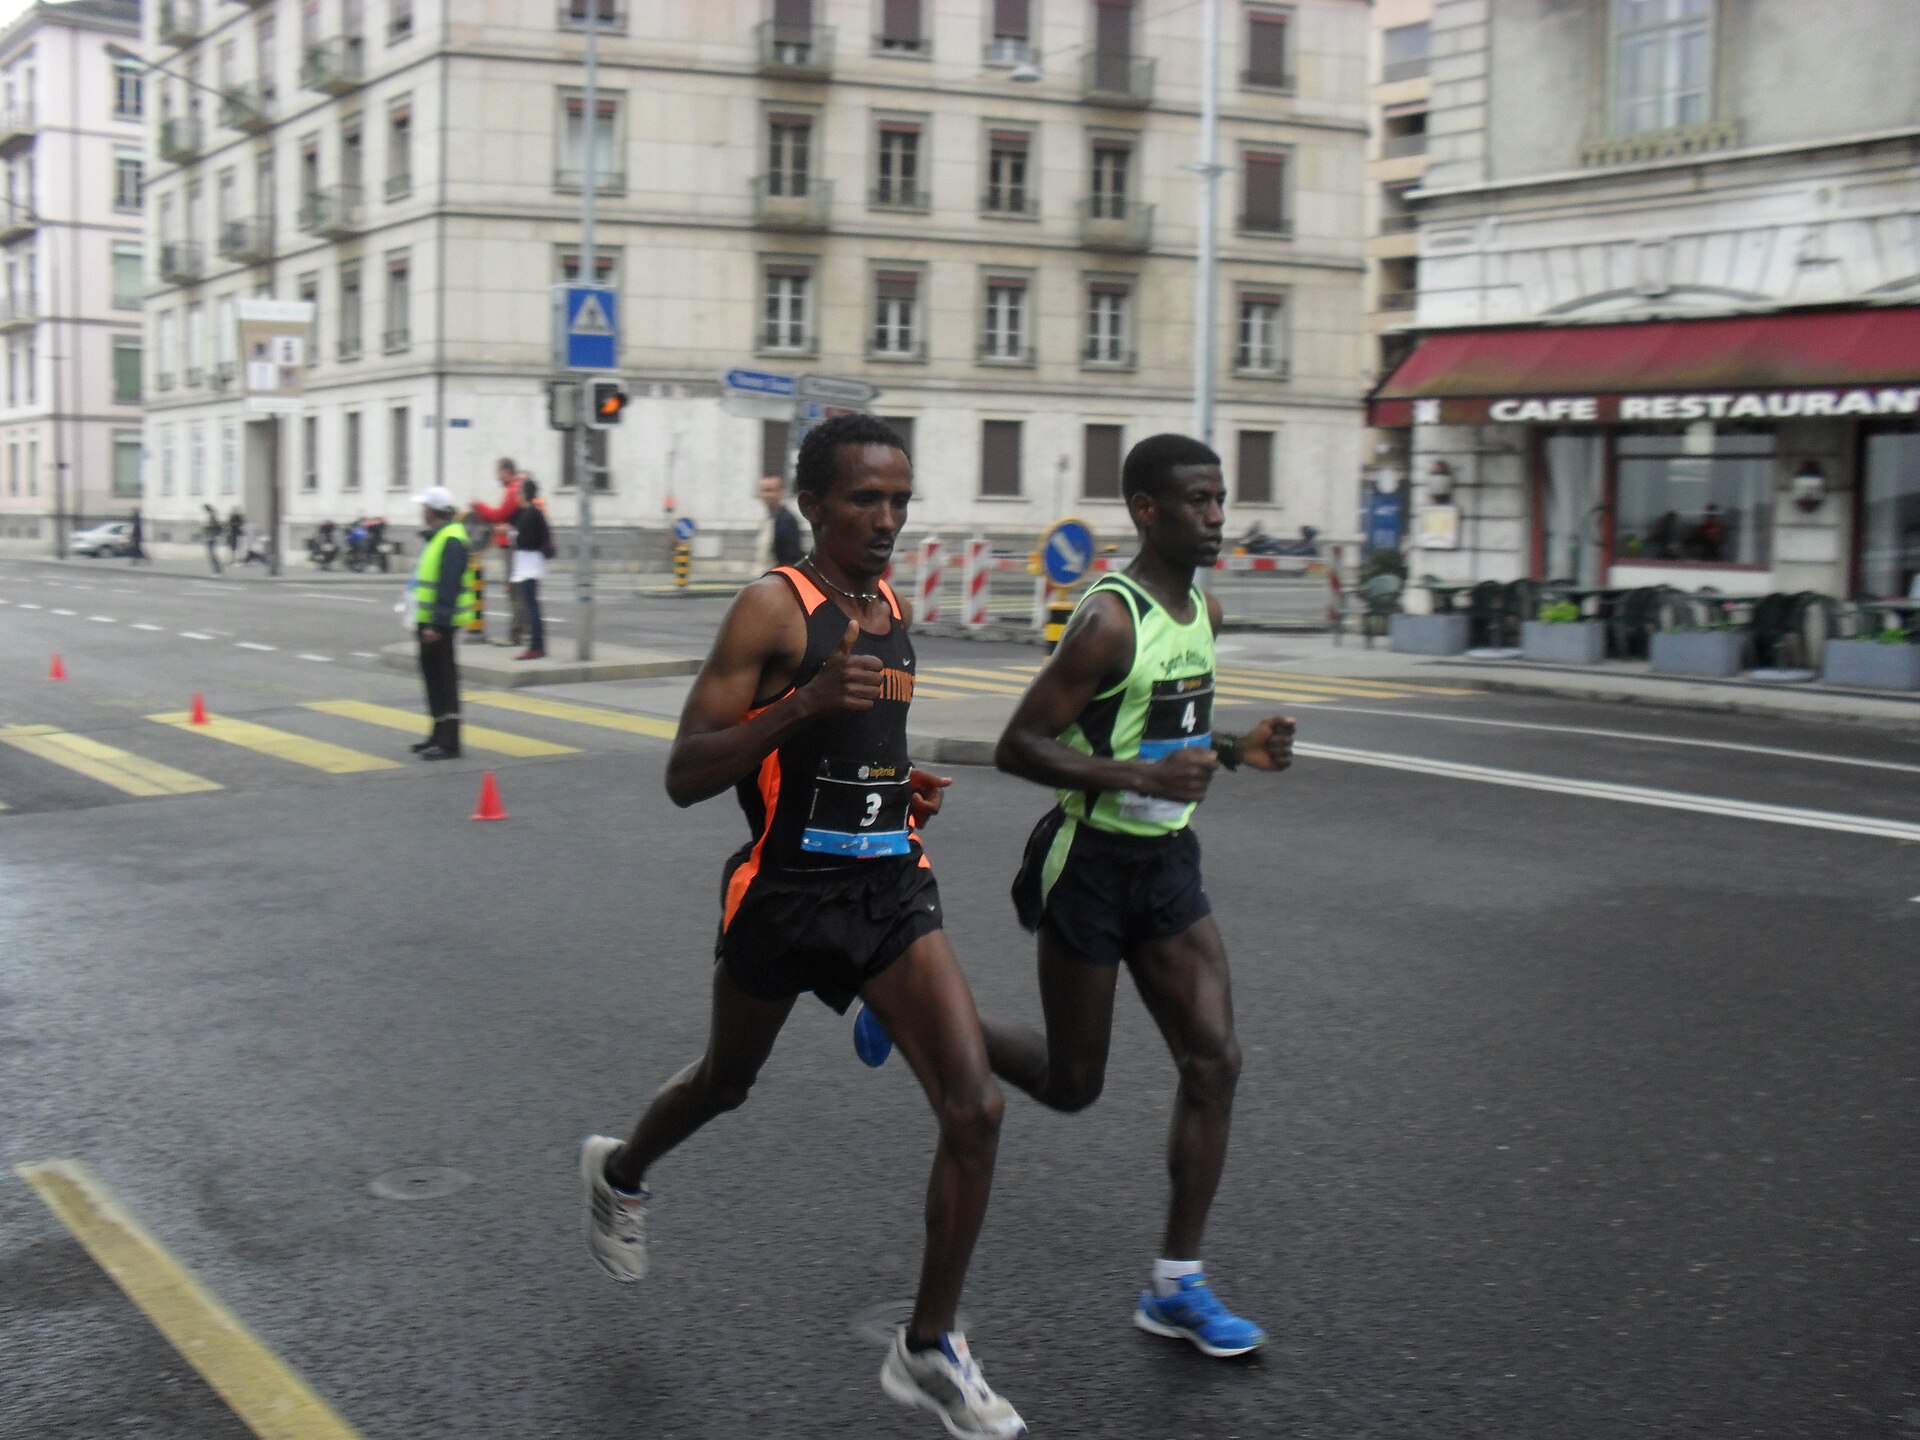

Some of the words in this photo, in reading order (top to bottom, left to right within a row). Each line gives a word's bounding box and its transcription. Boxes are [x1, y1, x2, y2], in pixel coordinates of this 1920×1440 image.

[1489, 397, 1600, 421] CAFE
[1619, 389, 1920, 419] RESTAURAN
[1181, 701, 1197, 733] 4
[859, 792, 882, 827] 3
